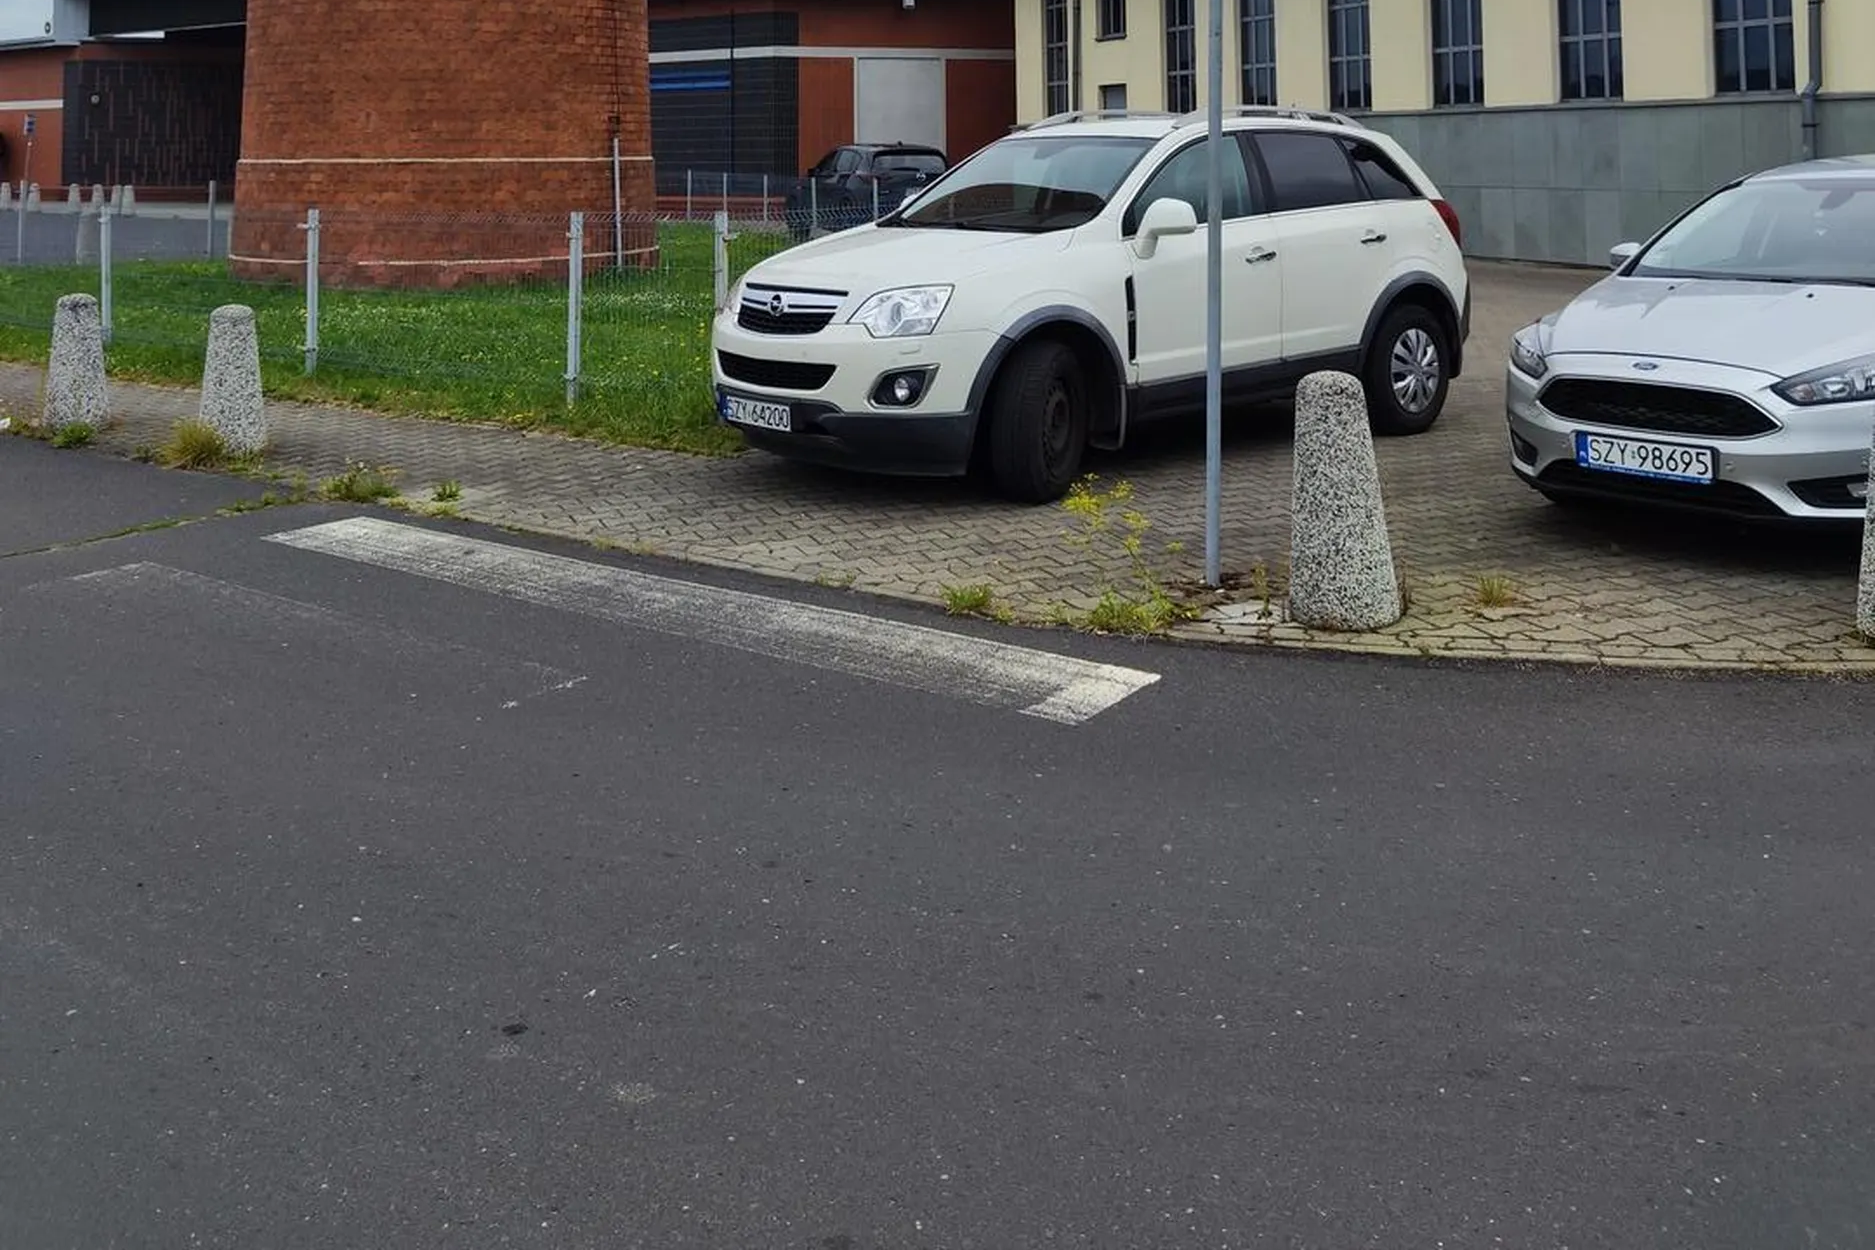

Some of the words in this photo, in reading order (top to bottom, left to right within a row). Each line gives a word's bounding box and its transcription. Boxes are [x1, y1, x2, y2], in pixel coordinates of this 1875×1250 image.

[752, 404, 789, 428] 64200
[1590, 439, 1628, 465] SZY
[1637, 445, 1709, 476] 98695
